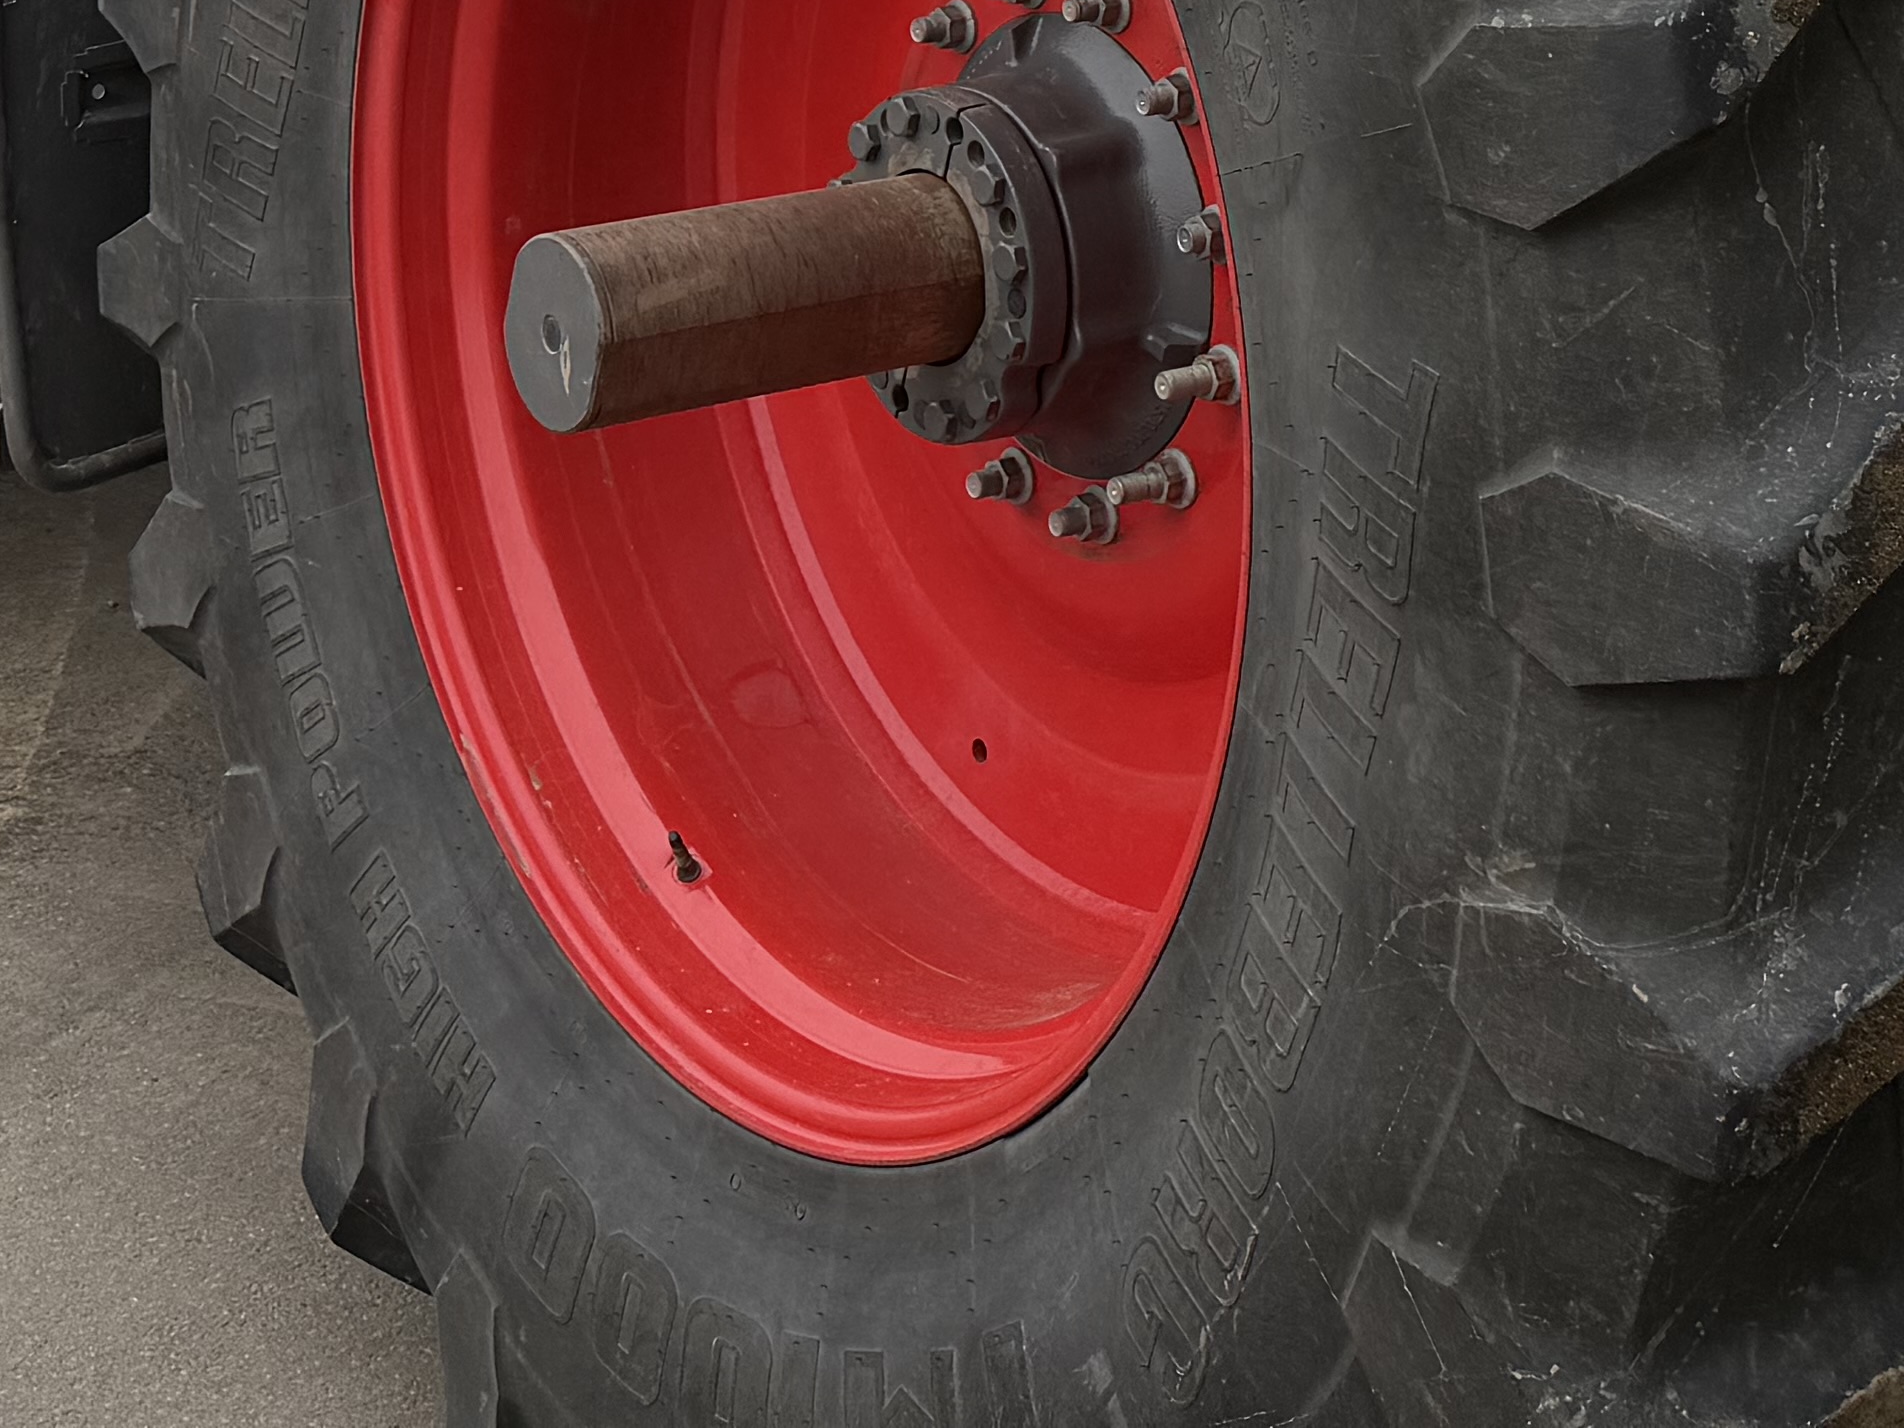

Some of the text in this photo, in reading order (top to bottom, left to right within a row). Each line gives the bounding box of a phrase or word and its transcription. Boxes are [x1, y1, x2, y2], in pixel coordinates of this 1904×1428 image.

[231, 397, 496, 1138] HIGH POWER
[1121, 344, 1441, 1406] TRELLEBORG
